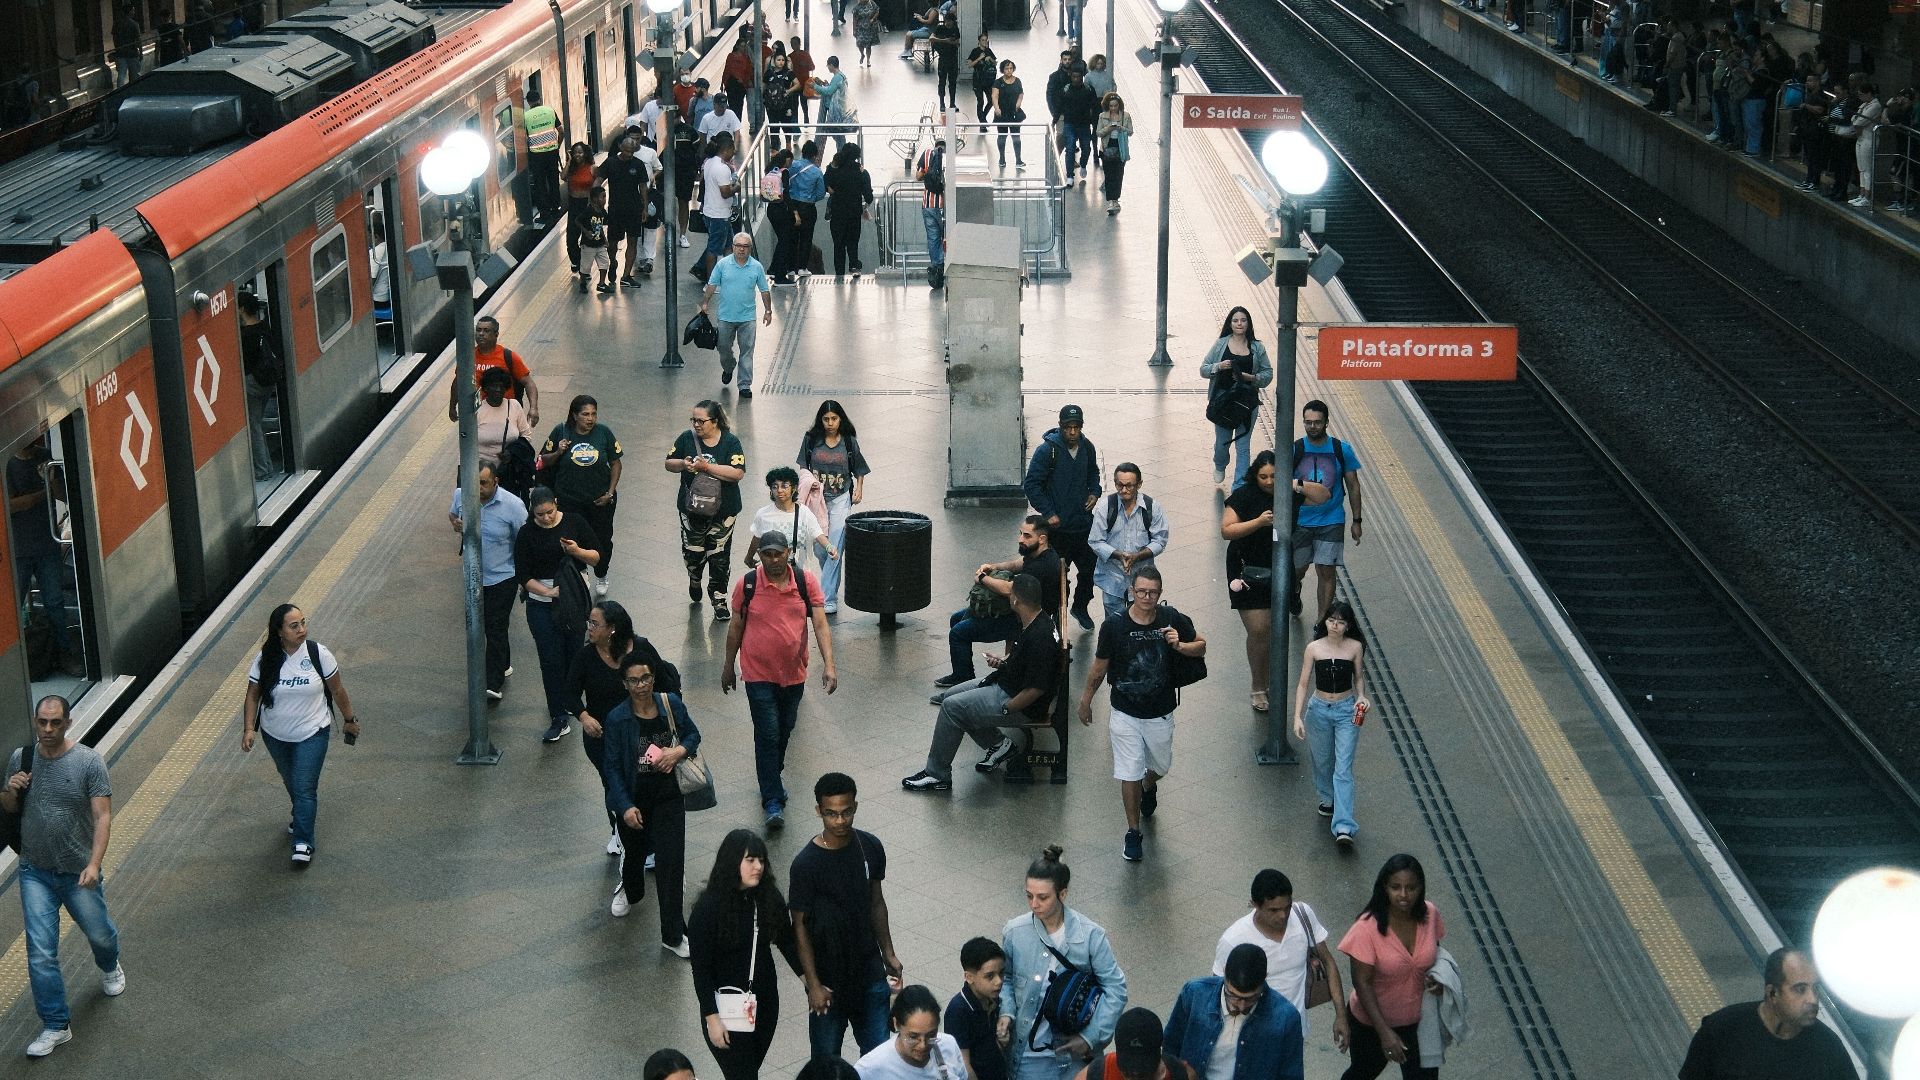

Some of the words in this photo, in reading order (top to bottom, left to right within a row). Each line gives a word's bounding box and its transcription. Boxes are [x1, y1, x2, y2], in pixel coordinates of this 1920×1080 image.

[1207, 106, 1251, 119] Saída
[210, 289, 228, 318] H570
[1342, 338, 1474, 357] Plataforma
[1480, 340, 1494, 357] 3
[1340, 359, 1382, 368] Platform
[95, 371, 118, 406] H569
